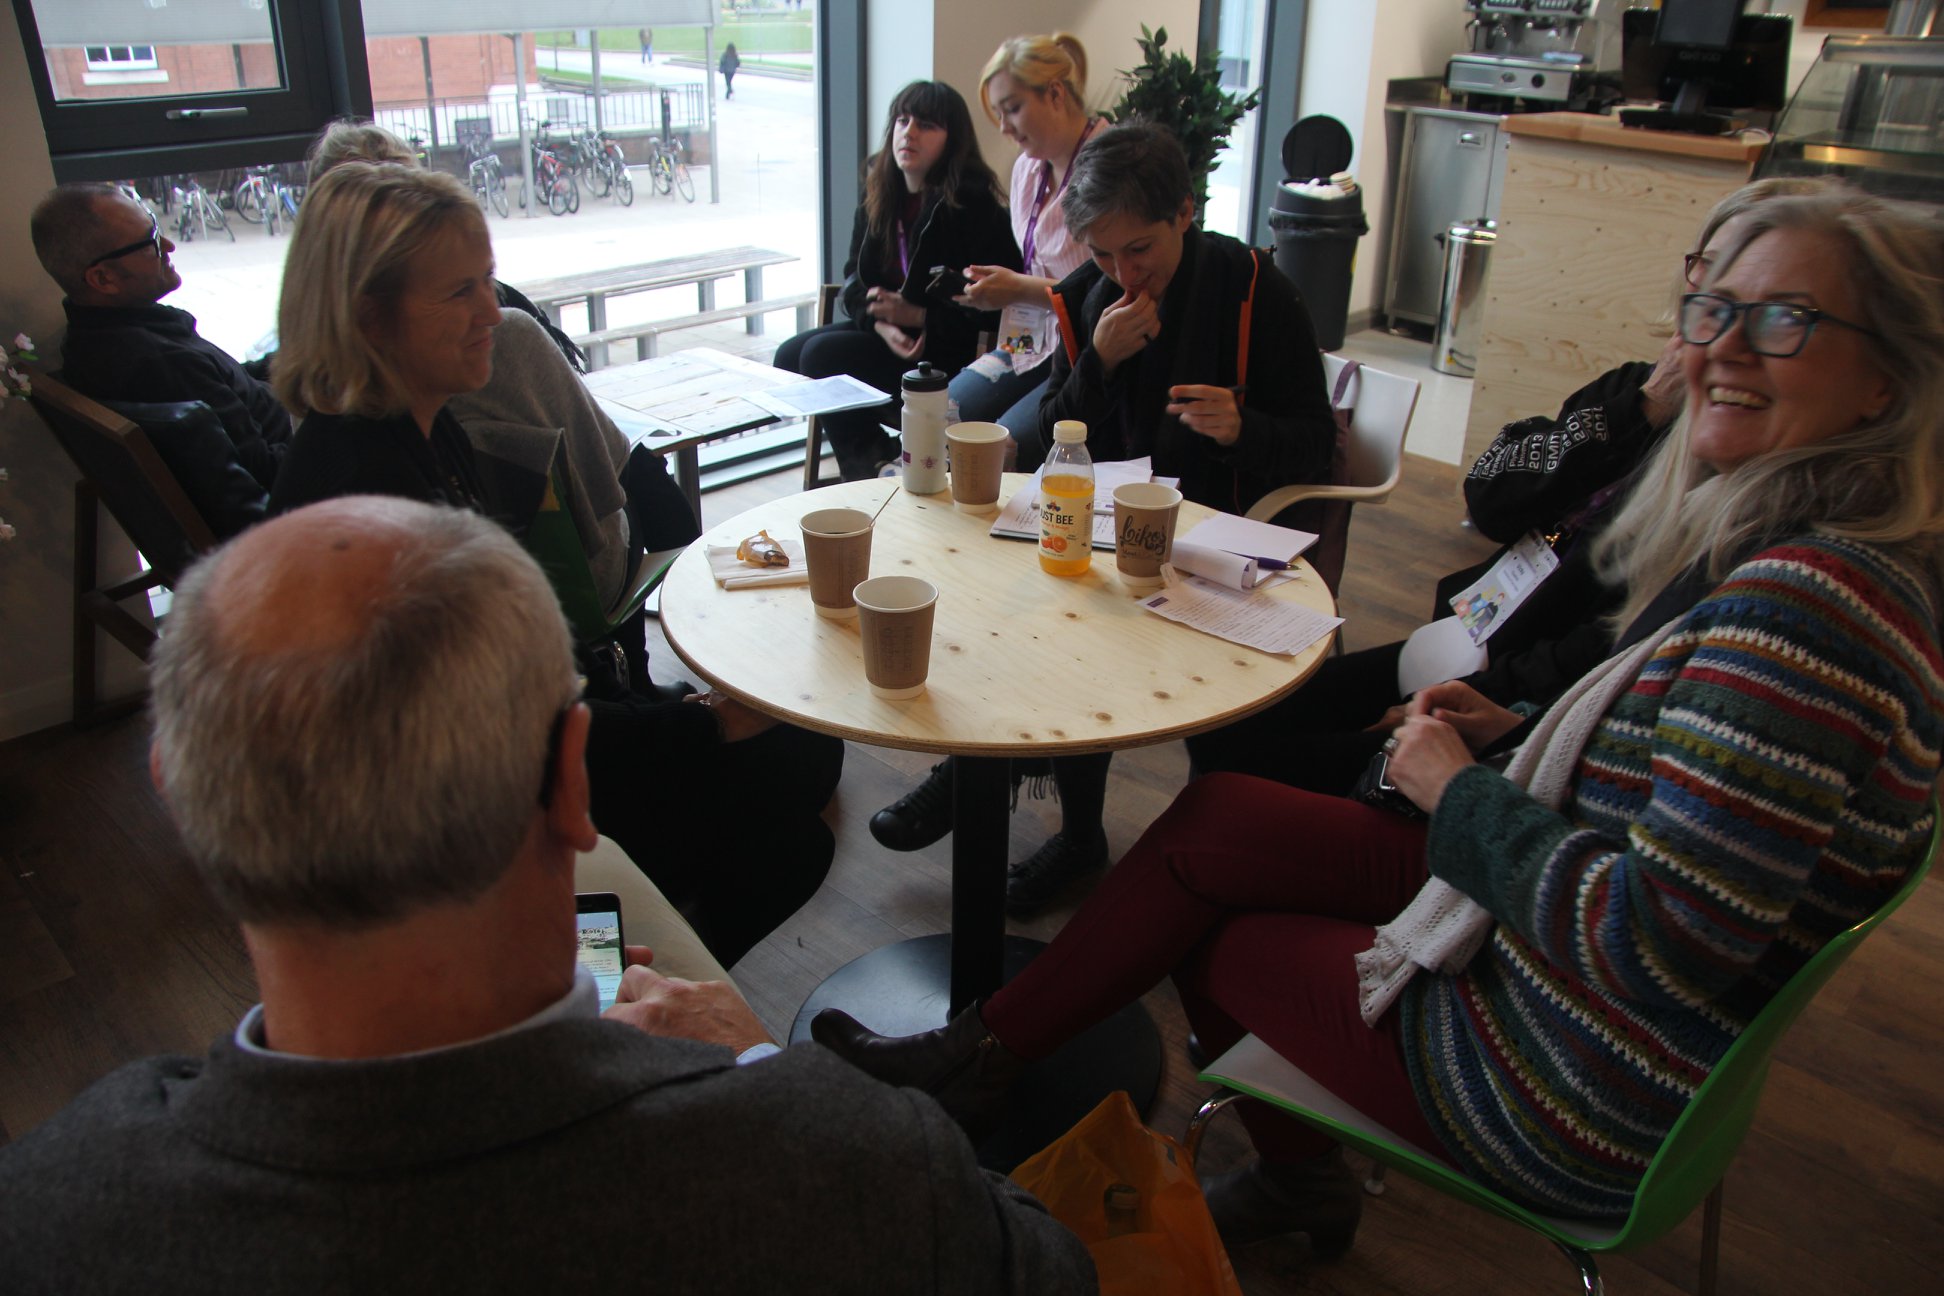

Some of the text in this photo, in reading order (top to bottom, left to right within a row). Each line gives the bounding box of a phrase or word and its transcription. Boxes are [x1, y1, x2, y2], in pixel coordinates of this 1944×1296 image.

[1528, 434, 1544, 470] 2013
[1546, 434, 1560, 470] GMIT
[1056, 514, 1074, 526] BEE
